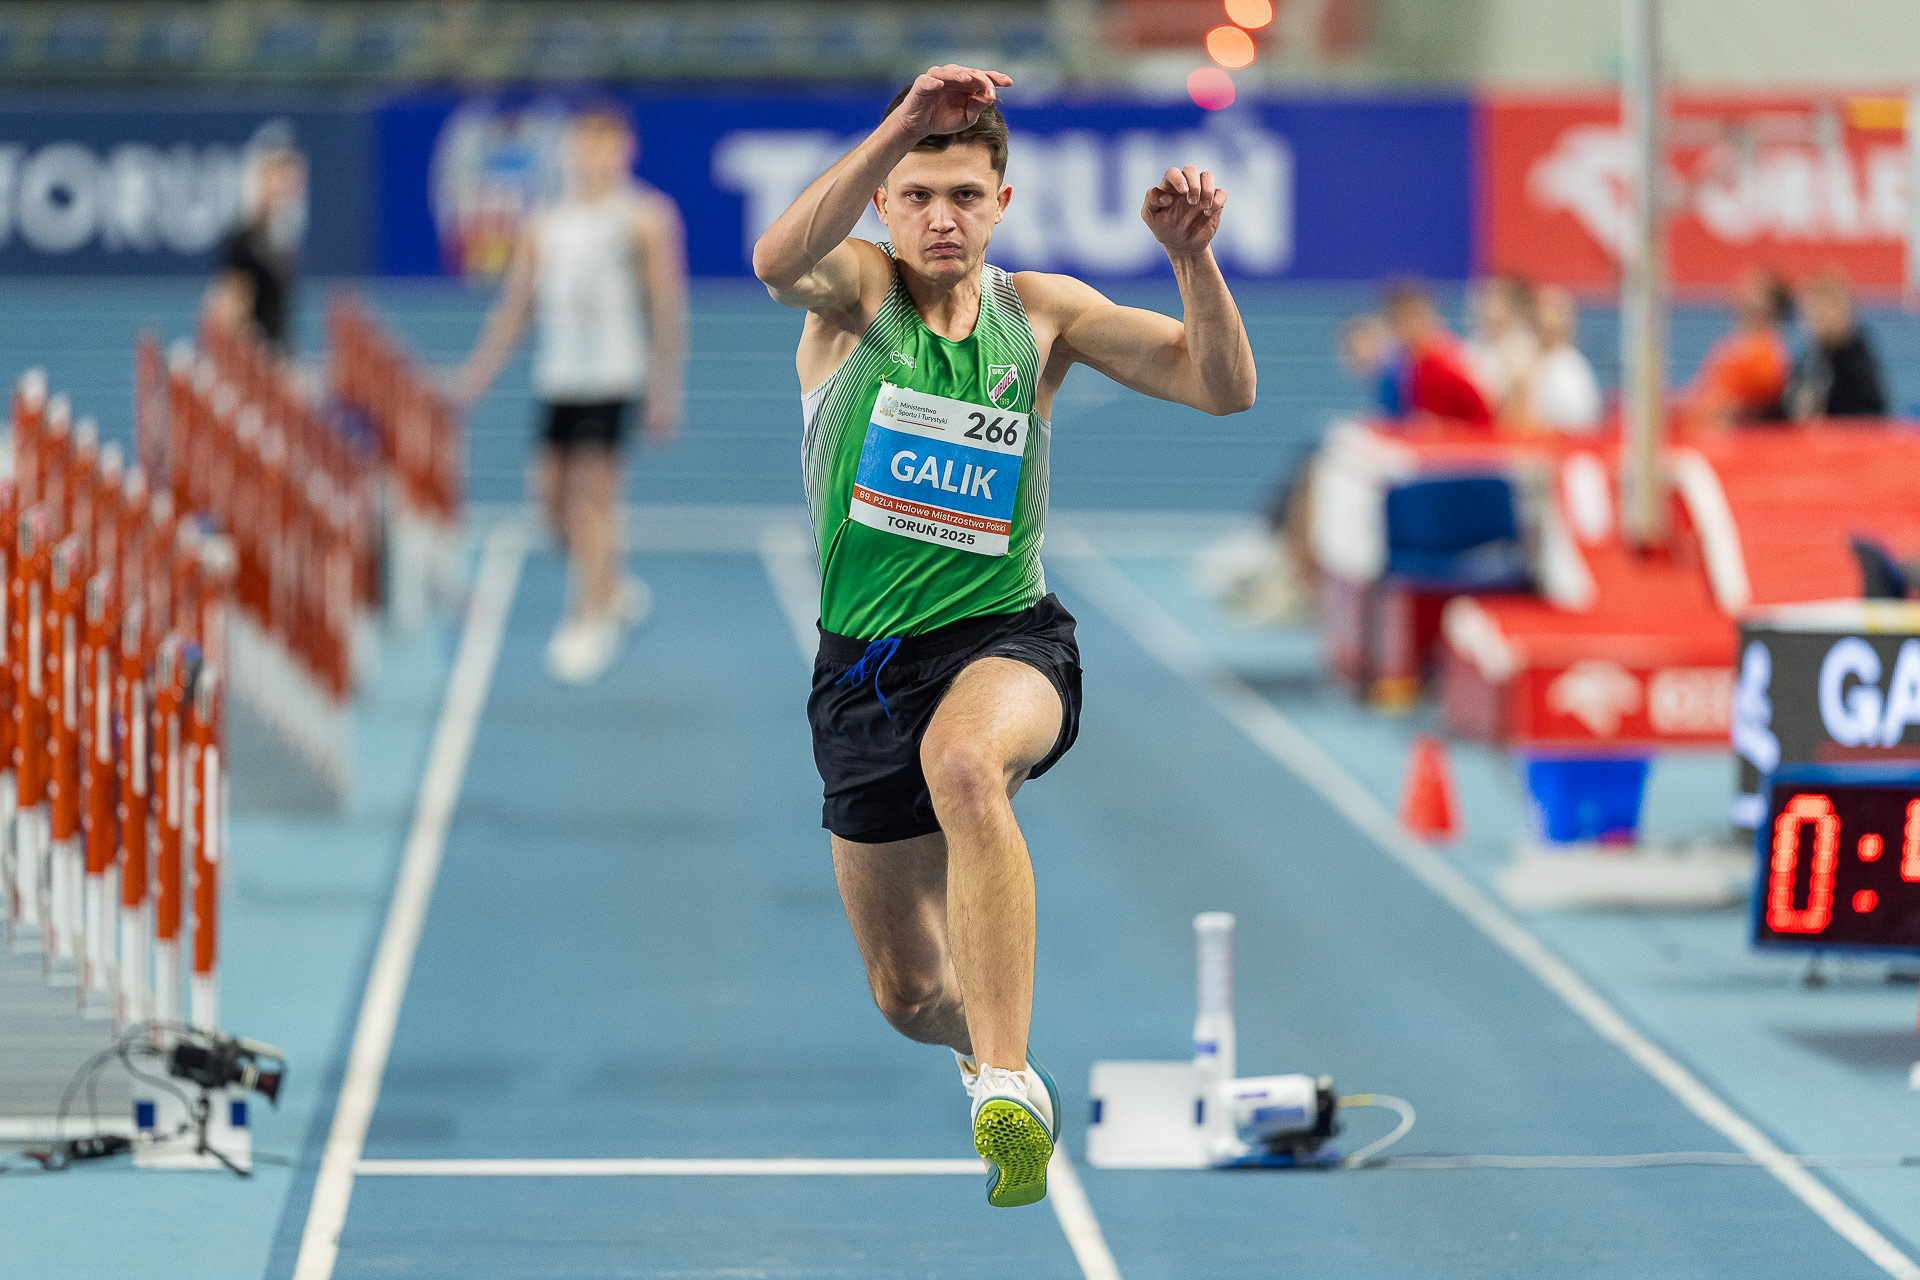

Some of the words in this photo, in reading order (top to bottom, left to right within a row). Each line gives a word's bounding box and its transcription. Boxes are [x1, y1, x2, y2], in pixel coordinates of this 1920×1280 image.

[897, 409, 918, 419] Sportu
[921, 413, 948, 425] Turystyki
[899, 402, 937, 415] Ministerstwo
[963, 412, 1019, 446] 266
[890, 450, 998, 500] GALIK
[859, 490, 872, 502] 69.
[873, 495, 893, 508] PZLA
[895, 502, 930, 517] Halowe
[931, 510, 985, 529] Mistrzostwa
[985, 521, 1007, 533] Polski
[887, 515, 938, 537] TORUŃ
[939, 528, 976, 545] 2025
